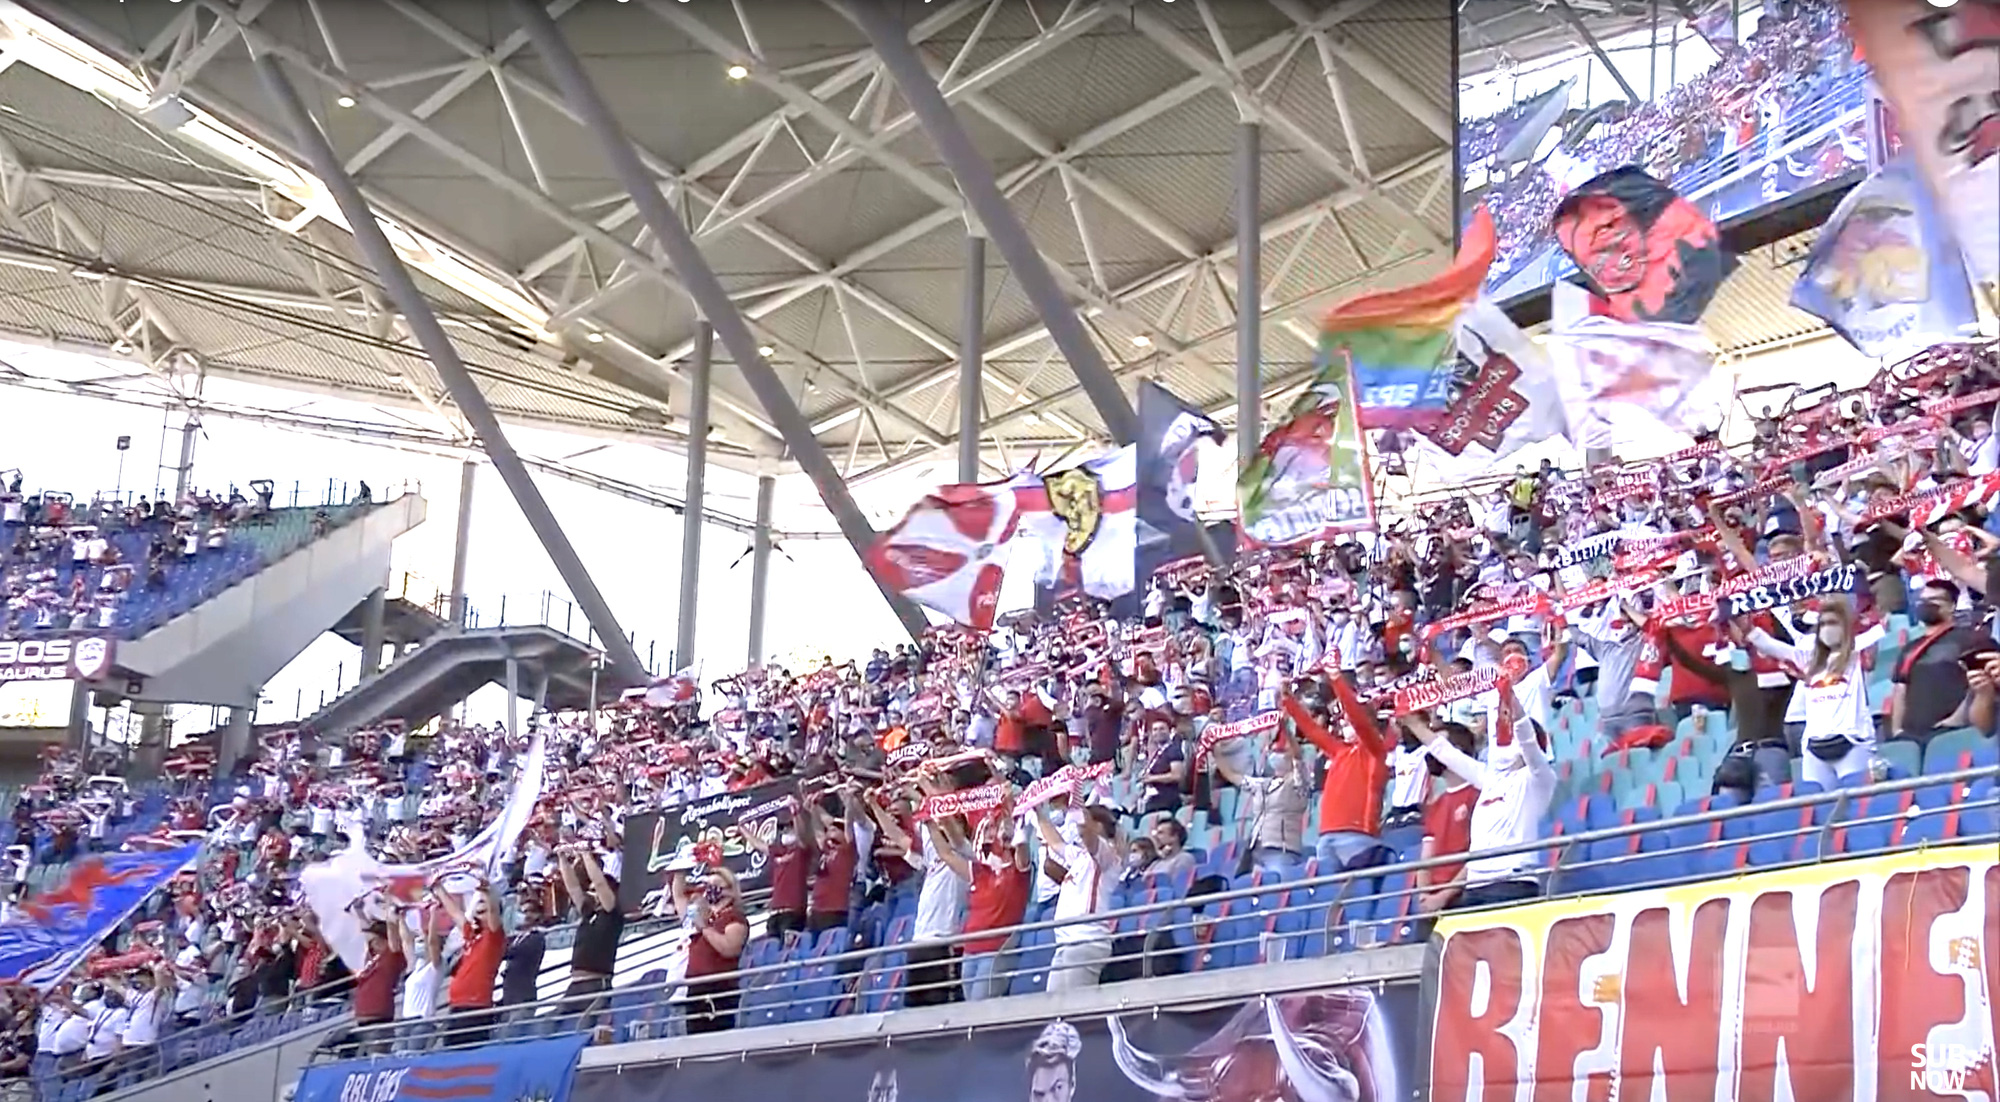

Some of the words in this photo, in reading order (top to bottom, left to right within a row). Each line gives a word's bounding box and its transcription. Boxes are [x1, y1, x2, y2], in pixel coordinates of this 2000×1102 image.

[1729, 586, 1775, 615] RB
[1775, 563, 1857, 604] LEIPZIG
[1430, 864, 2000, 1102] RENNE
